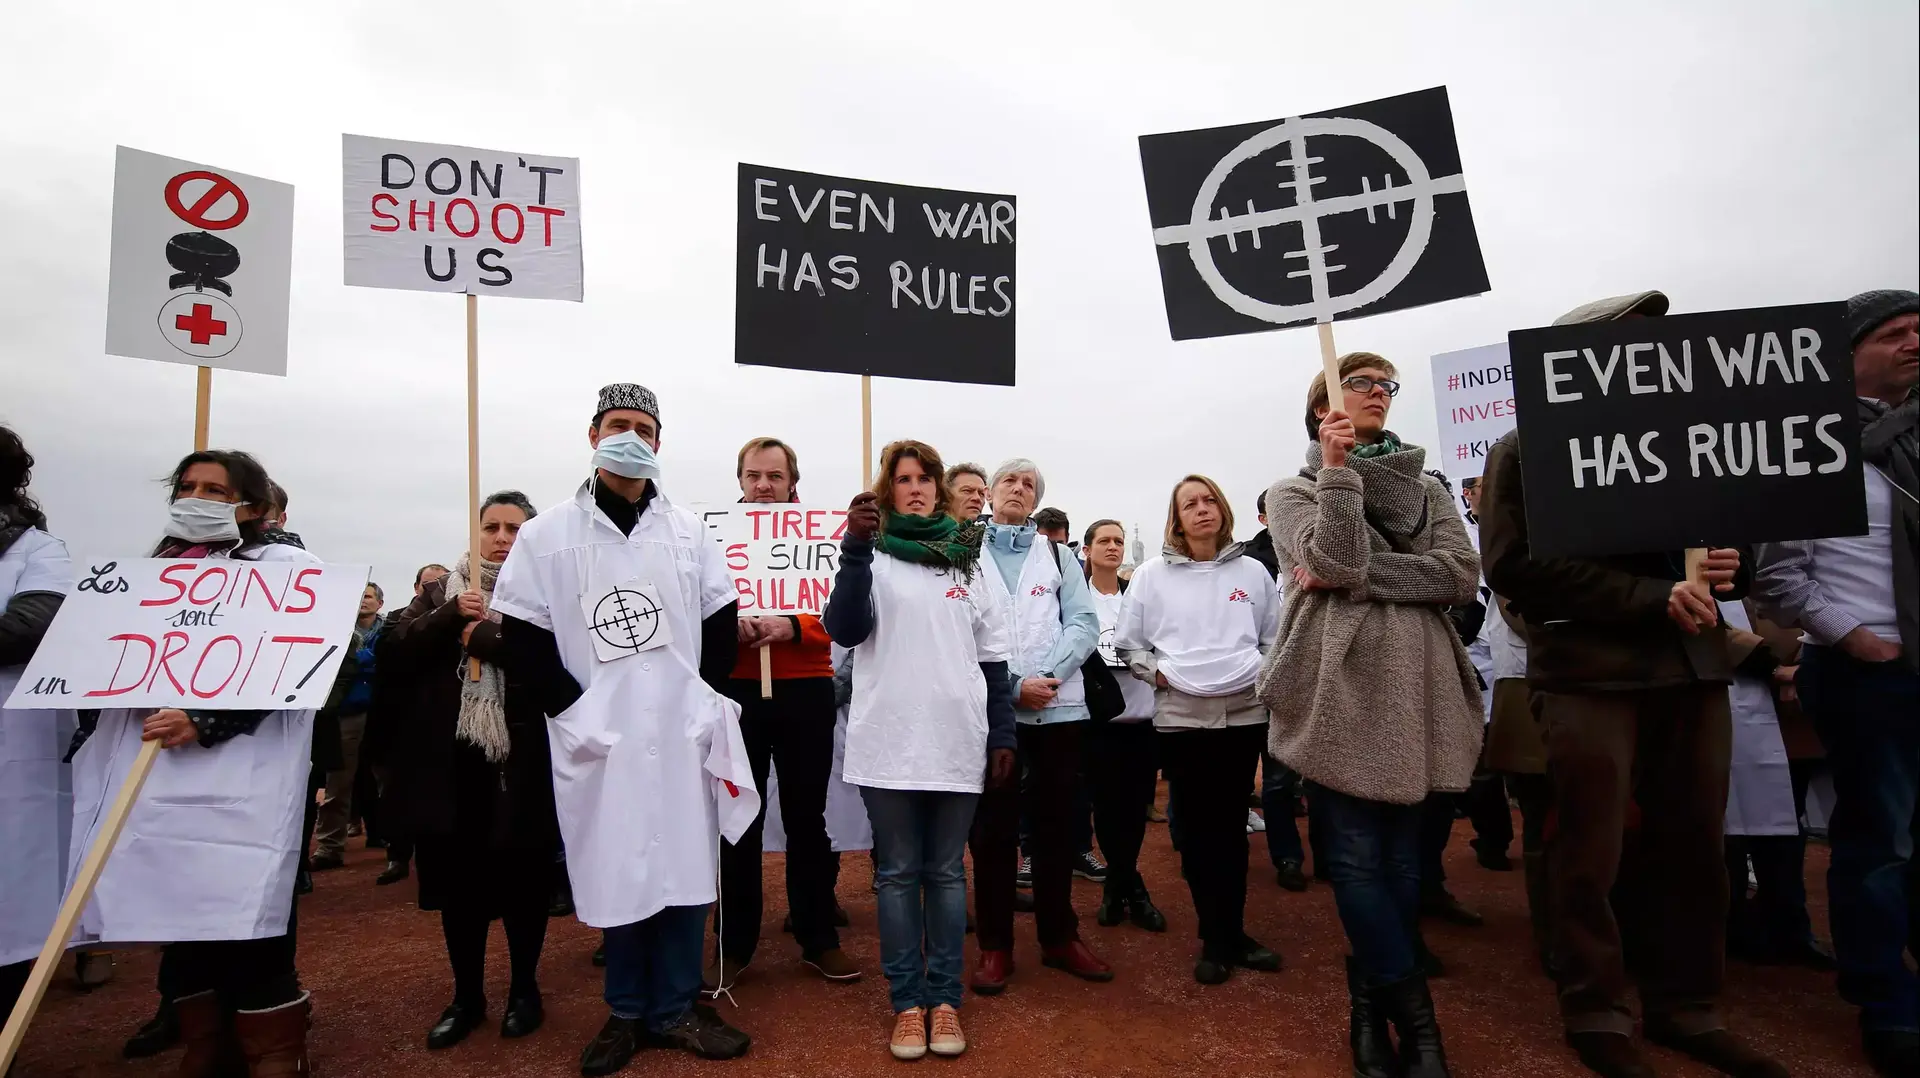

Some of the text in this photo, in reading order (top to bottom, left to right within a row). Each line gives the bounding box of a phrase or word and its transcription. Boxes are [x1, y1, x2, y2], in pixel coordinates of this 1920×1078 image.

[381, 153, 563, 205] DON'T
[370, 193, 565, 246] SHOOT
[755, 178, 1015, 244] EVEN WAR
[424, 244, 513, 287] US
[757, 243, 1011, 317] HAS RULES
[1447, 364, 1513, 391] #INDE
[1543, 327, 1830, 403] EVEN WAR
[1451, 398, 1516, 425] INVES
[1569, 413, 1847, 489] HAS RULES
[767, 543, 837, 571] SUR
[77, 561, 129, 594] Les
[733, 577, 830, 612] BULAN
[164, 602, 225, 627] sont
[25, 676, 72, 695] un
